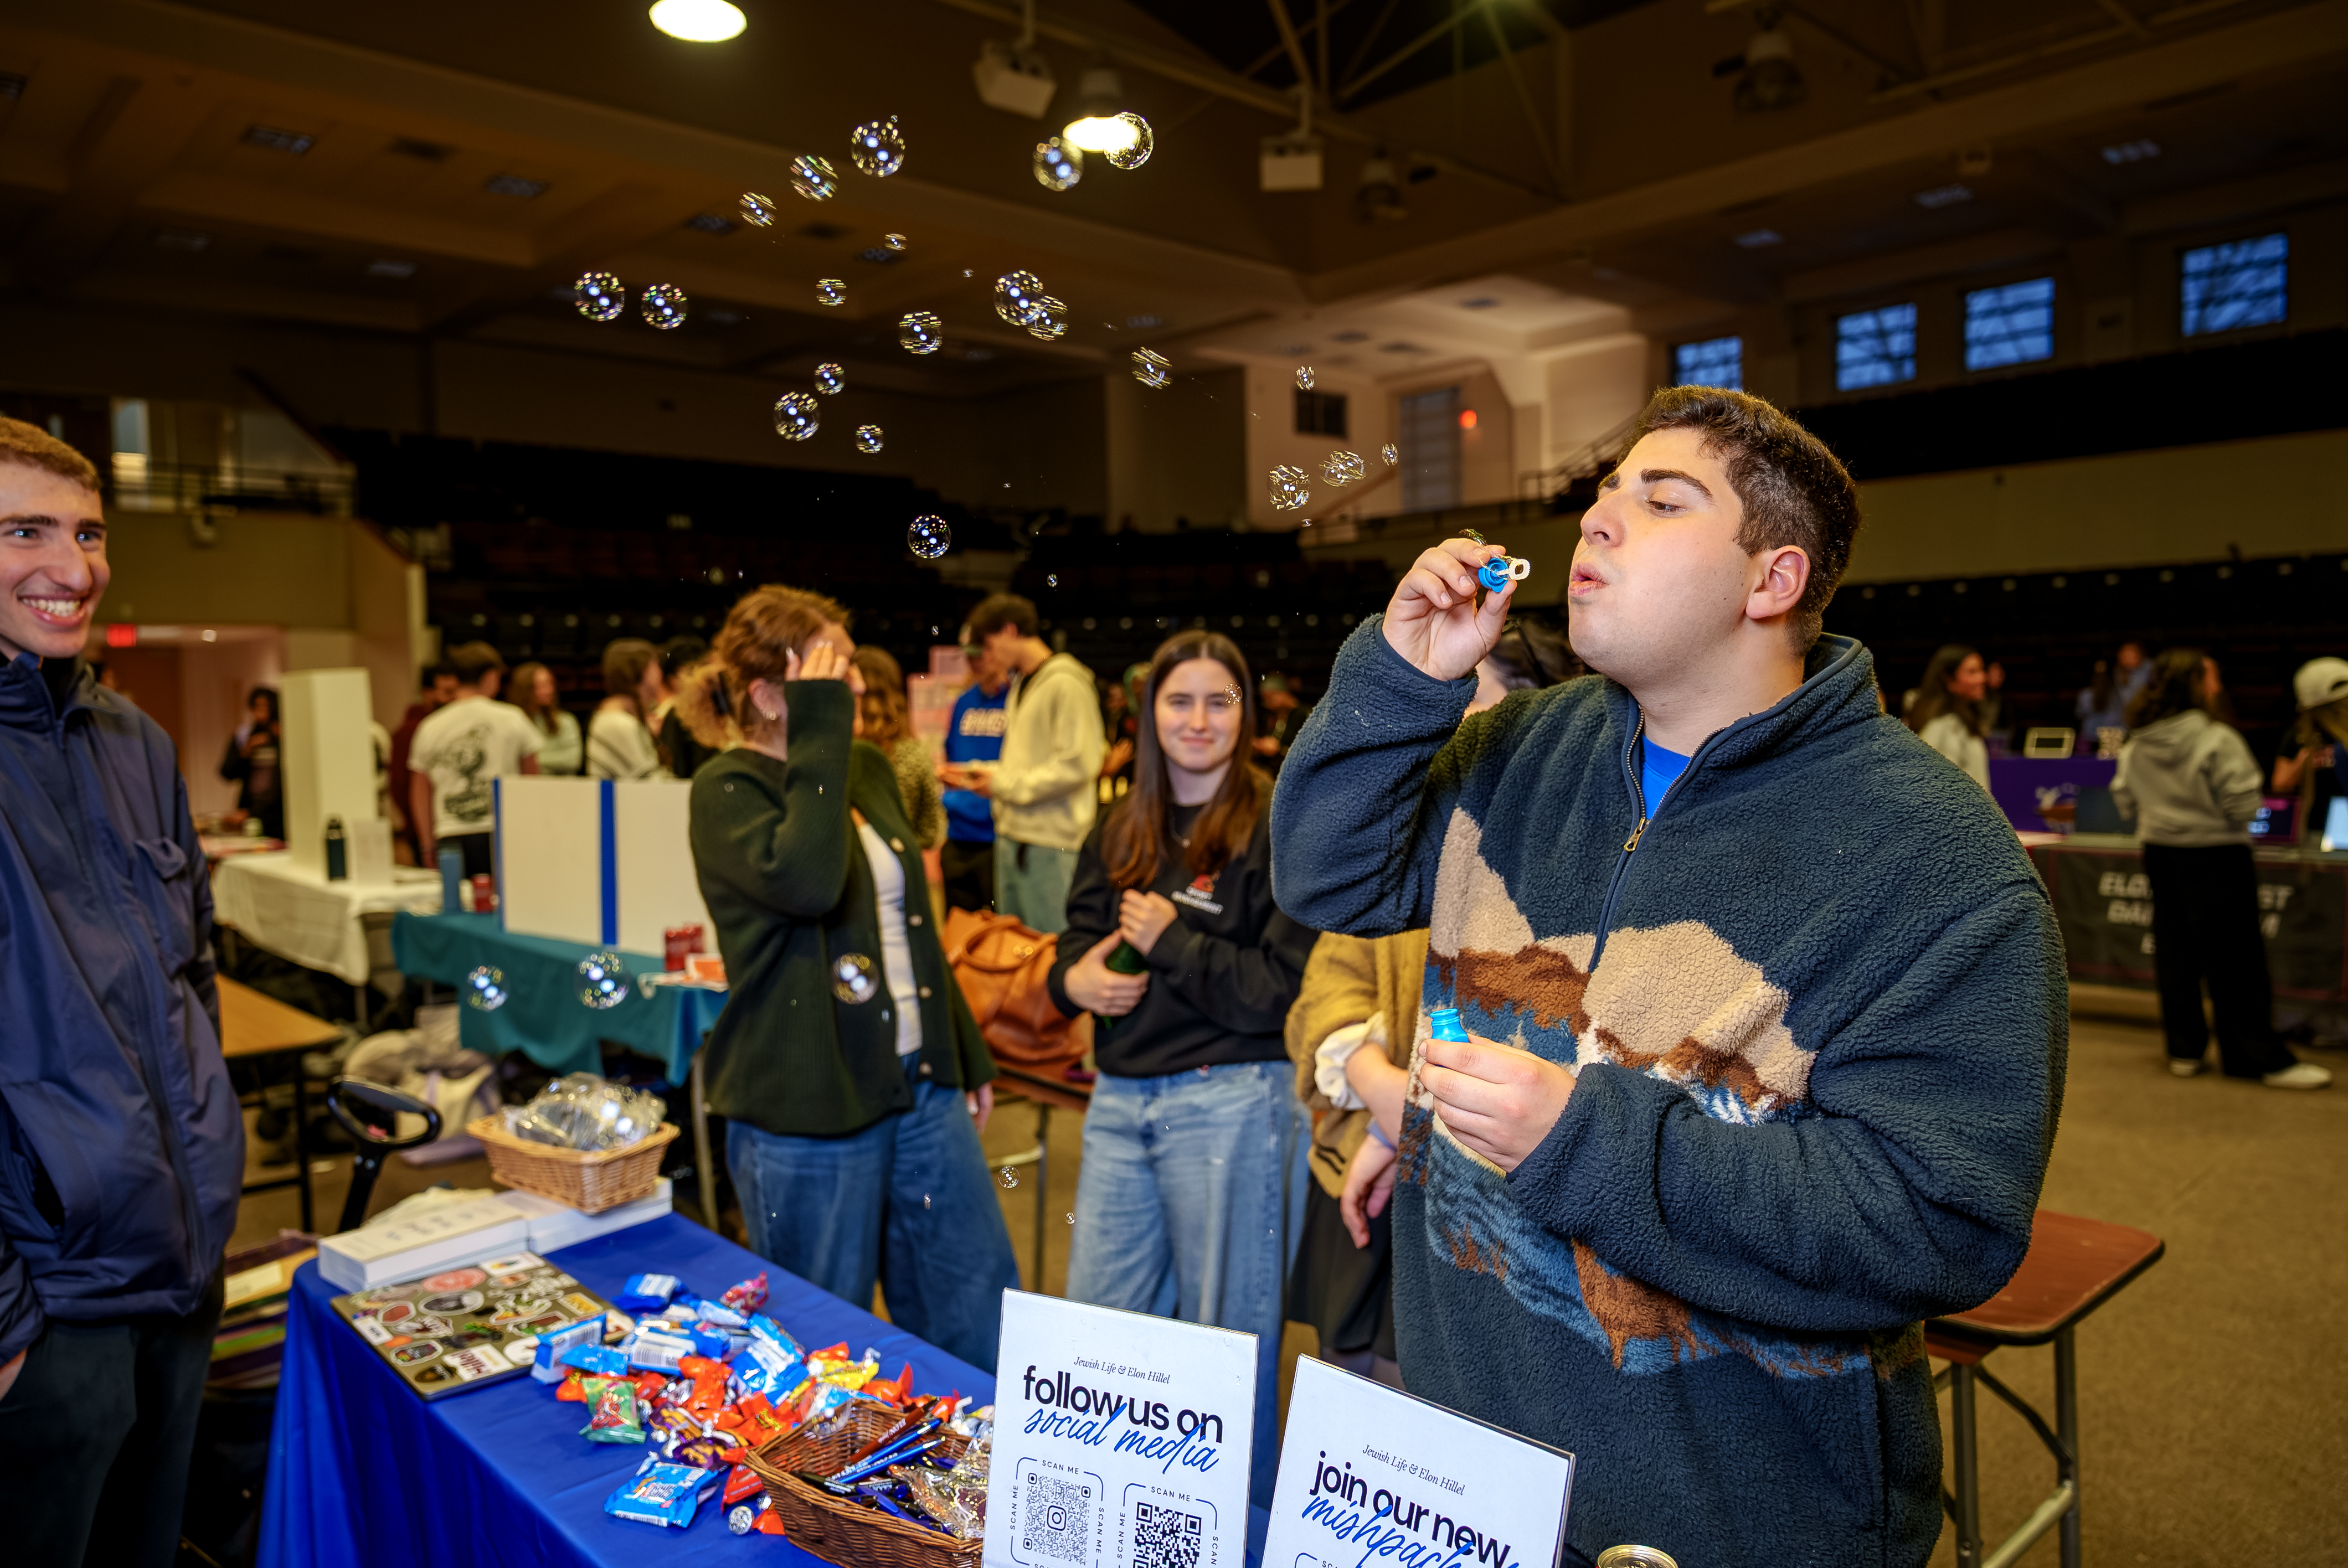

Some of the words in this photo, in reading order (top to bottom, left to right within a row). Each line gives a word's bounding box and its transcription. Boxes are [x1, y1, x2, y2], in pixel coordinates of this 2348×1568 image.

[1074, 1356, 1099, 1369] Jewish
[1101, 1361, 1116, 1375] Life
[1118, 1365, 1126, 1374] &
[1127, 1367, 1146, 1379] Elon
[1147, 1371, 1171, 1384] Hillel
[1023, 1365, 1124, 1419] follow
[1128, 1397, 1170, 1431] us
[1177, 1409, 1223, 1443] on
[1024, 1402, 1127, 1446] social
[1114, 1422, 1219, 1474] media
[1042, 1459, 1064, 1471] SCAN
[1067, 1466, 1079, 1475] ME
[1362, 1445, 1389, 1463] Jewish
[1391, 1456, 1408, 1472] Life
[1409, 1463, 1418, 1474] &
[1418, 1468, 1439, 1485] Elon
[1439, 1477, 1466, 1495] Hillel
[1012, 1485, 1019, 1499] ME
[1151, 1486, 1175, 1498] SCAN
[1178, 1493, 1191, 1502] ME
[1119, 1512, 1126, 1526] ME
[1309, 1450, 1368, 1509] join
[1373, 1489, 1430, 1533] our
[1432, 1513, 1511, 1568] new
[1095, 1539, 1103, 1554] ME
[1211, 1536, 1219, 1565] SCAN
